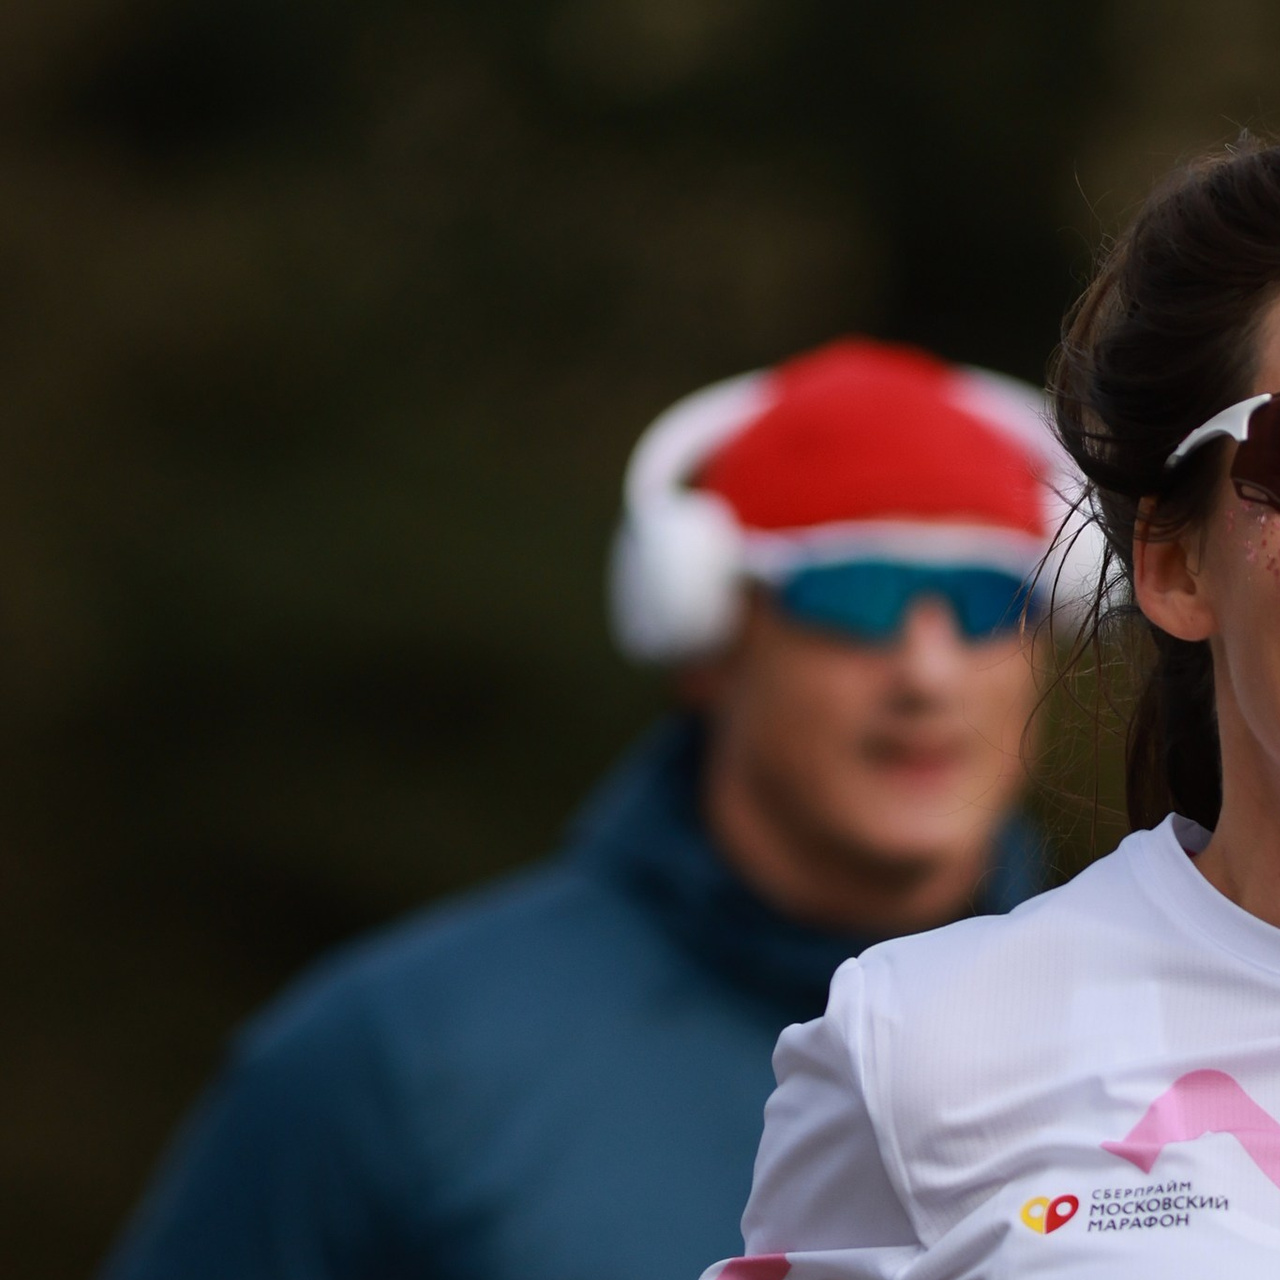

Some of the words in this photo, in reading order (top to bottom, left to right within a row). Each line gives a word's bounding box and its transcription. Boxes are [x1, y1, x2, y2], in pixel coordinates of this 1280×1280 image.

[1091, 1180, 1192, 1200] СБЕРПРАЙМ
[1089, 1195, 1229, 1217] МОСКОВСКИЙ
[1087, 1213, 1189, 1232] МАРАФОН
